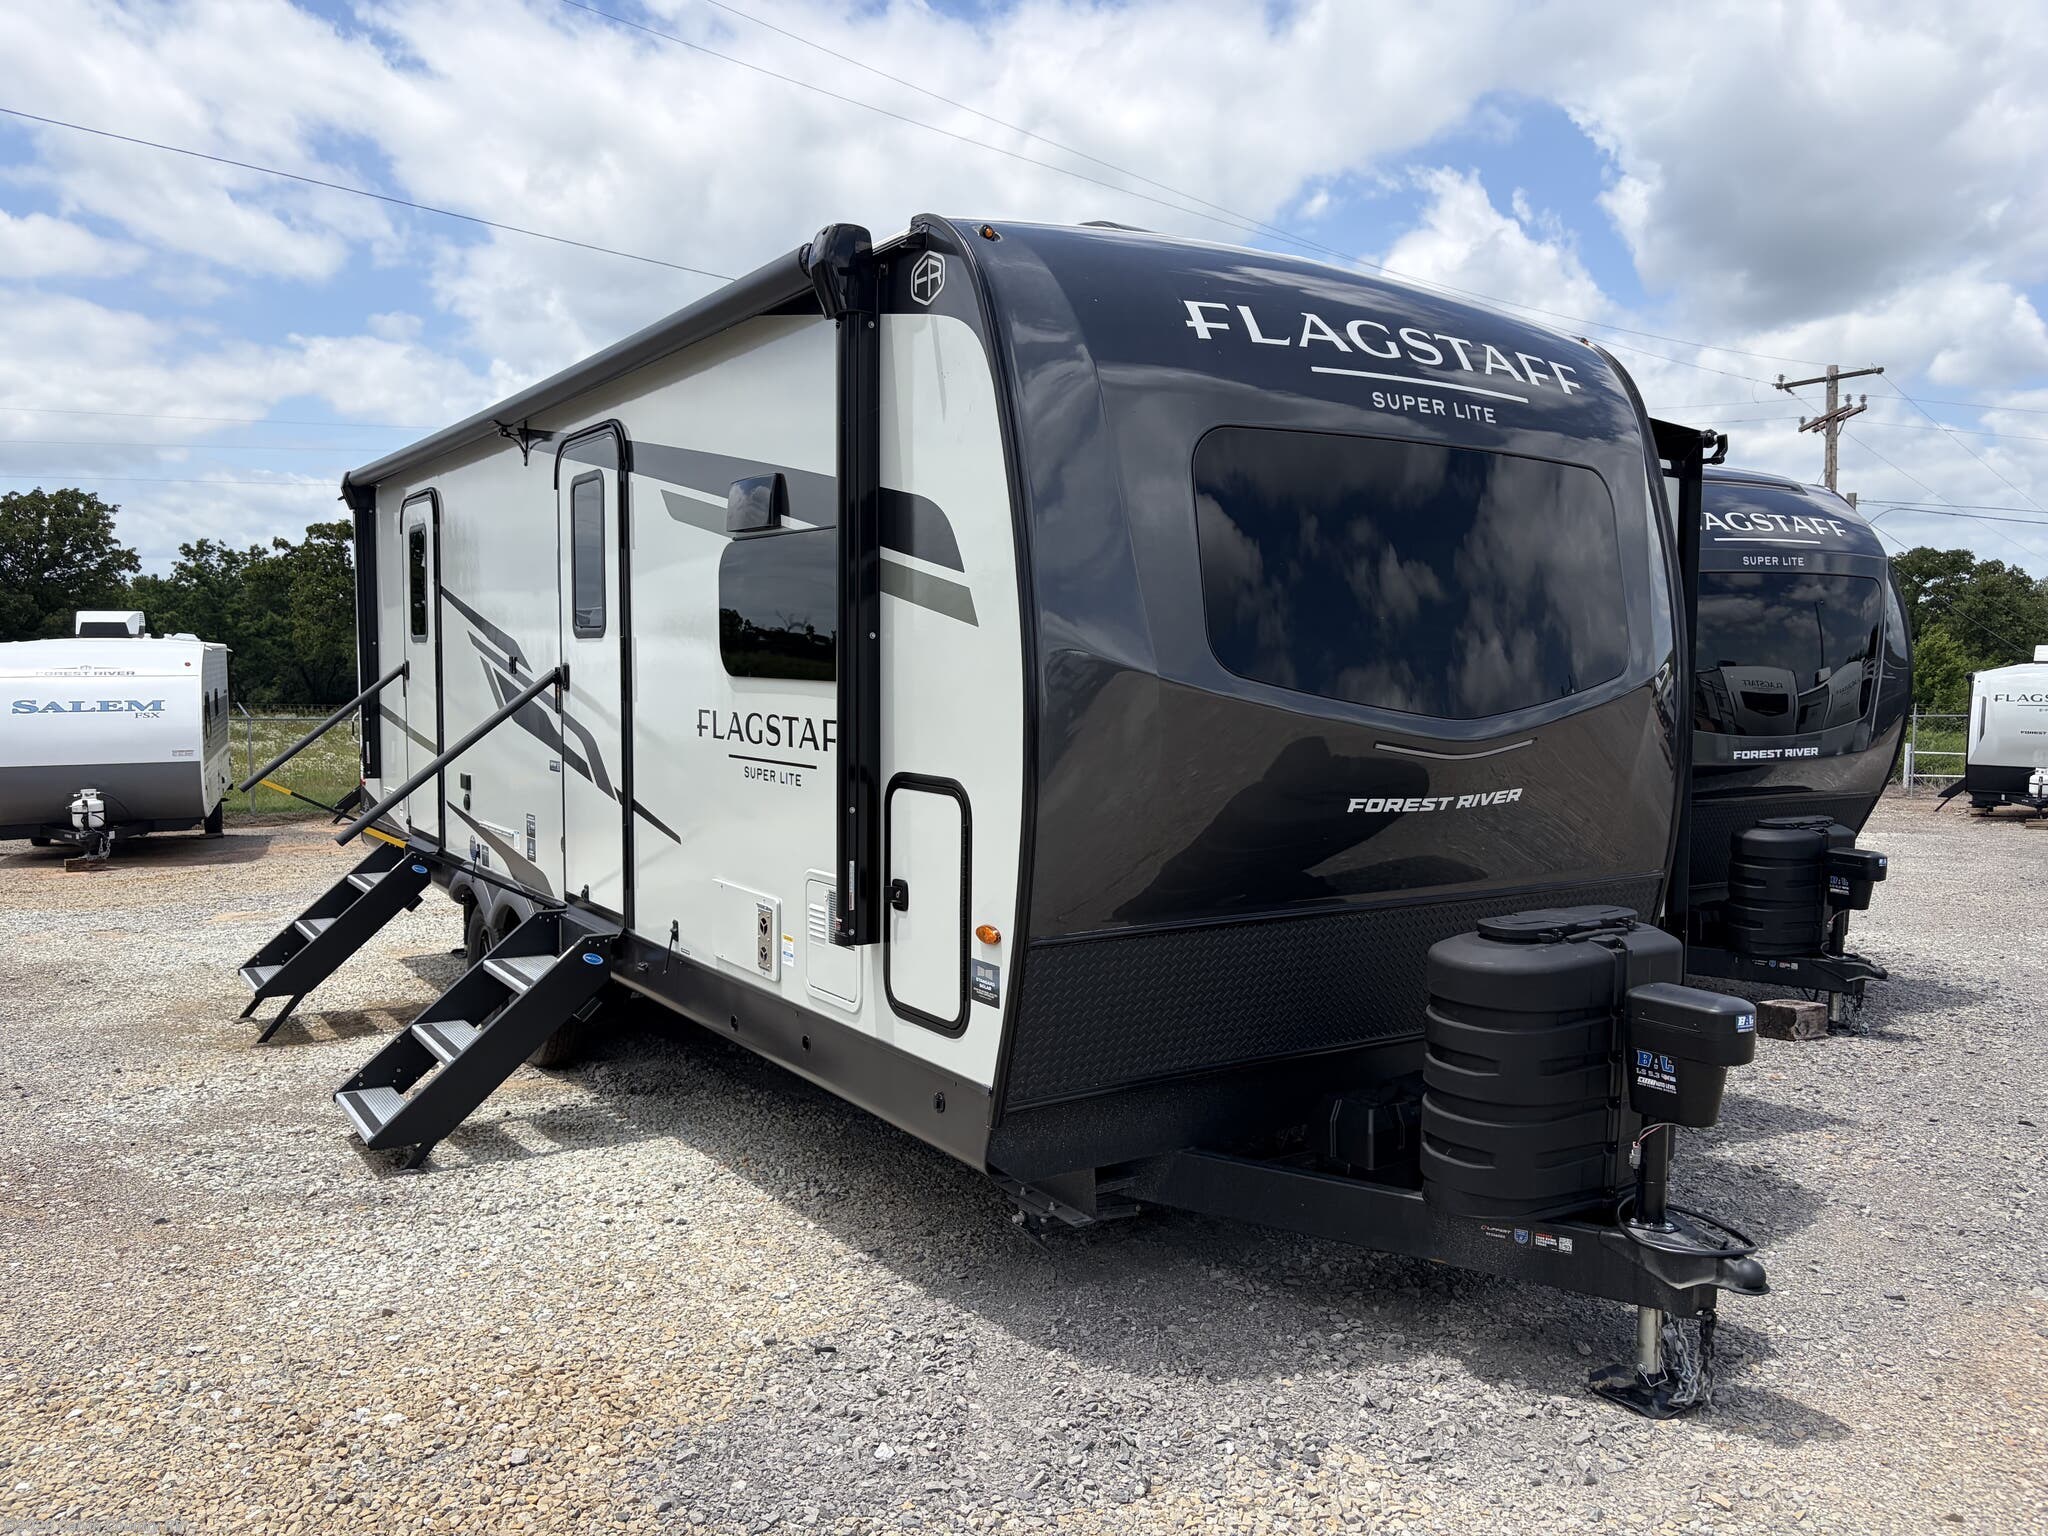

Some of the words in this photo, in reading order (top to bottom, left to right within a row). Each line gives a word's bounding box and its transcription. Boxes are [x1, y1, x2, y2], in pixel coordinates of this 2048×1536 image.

[1182, 300, 1582, 396] FLAGSTAFF
[1371, 391, 1446, 417] SUPER
[1453, 400, 1498, 424] LITE
[1699, 511, 1847, 537] AGSTAFF
[1742, 556, 1779, 567] SUPER
[1782, 556, 1805, 567] LITE
[11, 699, 165, 714] SALEM
[1733, 750, 1783, 760] FOREST
[1785, 746, 1819, 758] RIVER
[744, 766, 776, 783] SUPER
[779, 771, 802, 787] LITE
[1347, 797, 1454, 813] FOREST
[1456, 787, 1523, 810] RIVER
